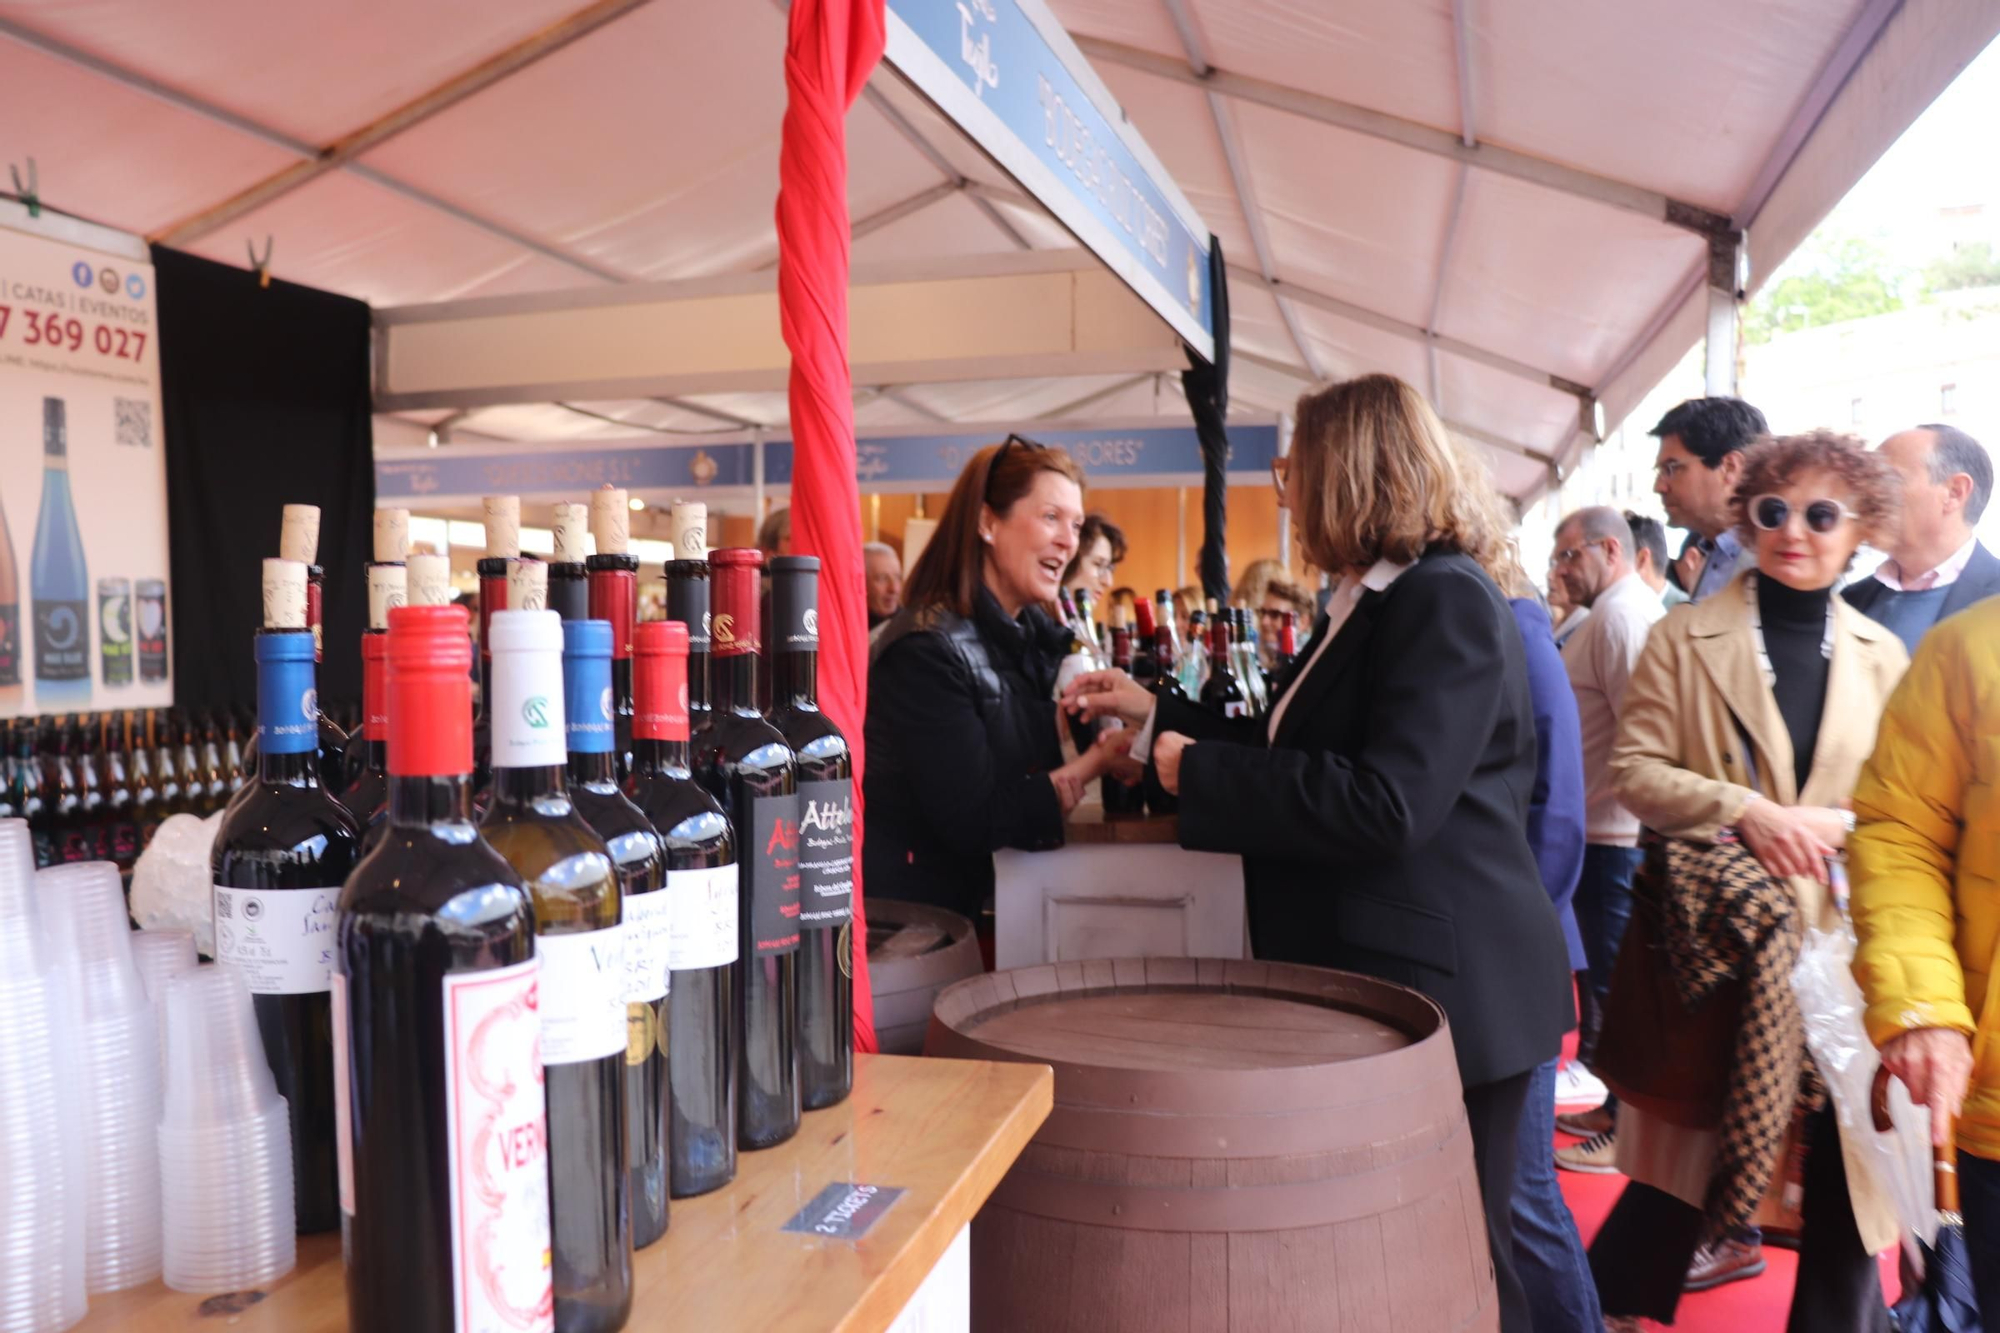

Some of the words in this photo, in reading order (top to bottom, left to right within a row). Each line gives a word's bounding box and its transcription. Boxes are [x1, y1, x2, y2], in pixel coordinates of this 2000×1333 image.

[12, 283, 66, 309] CATAS
[79, 297, 149, 325] EVENTOS
[24, 309, 83, 352] 369
[95, 324, 147, 363] 027
[823, 1185, 878, 1223] TICKETS
[815, 1224, 838, 1234] 2
